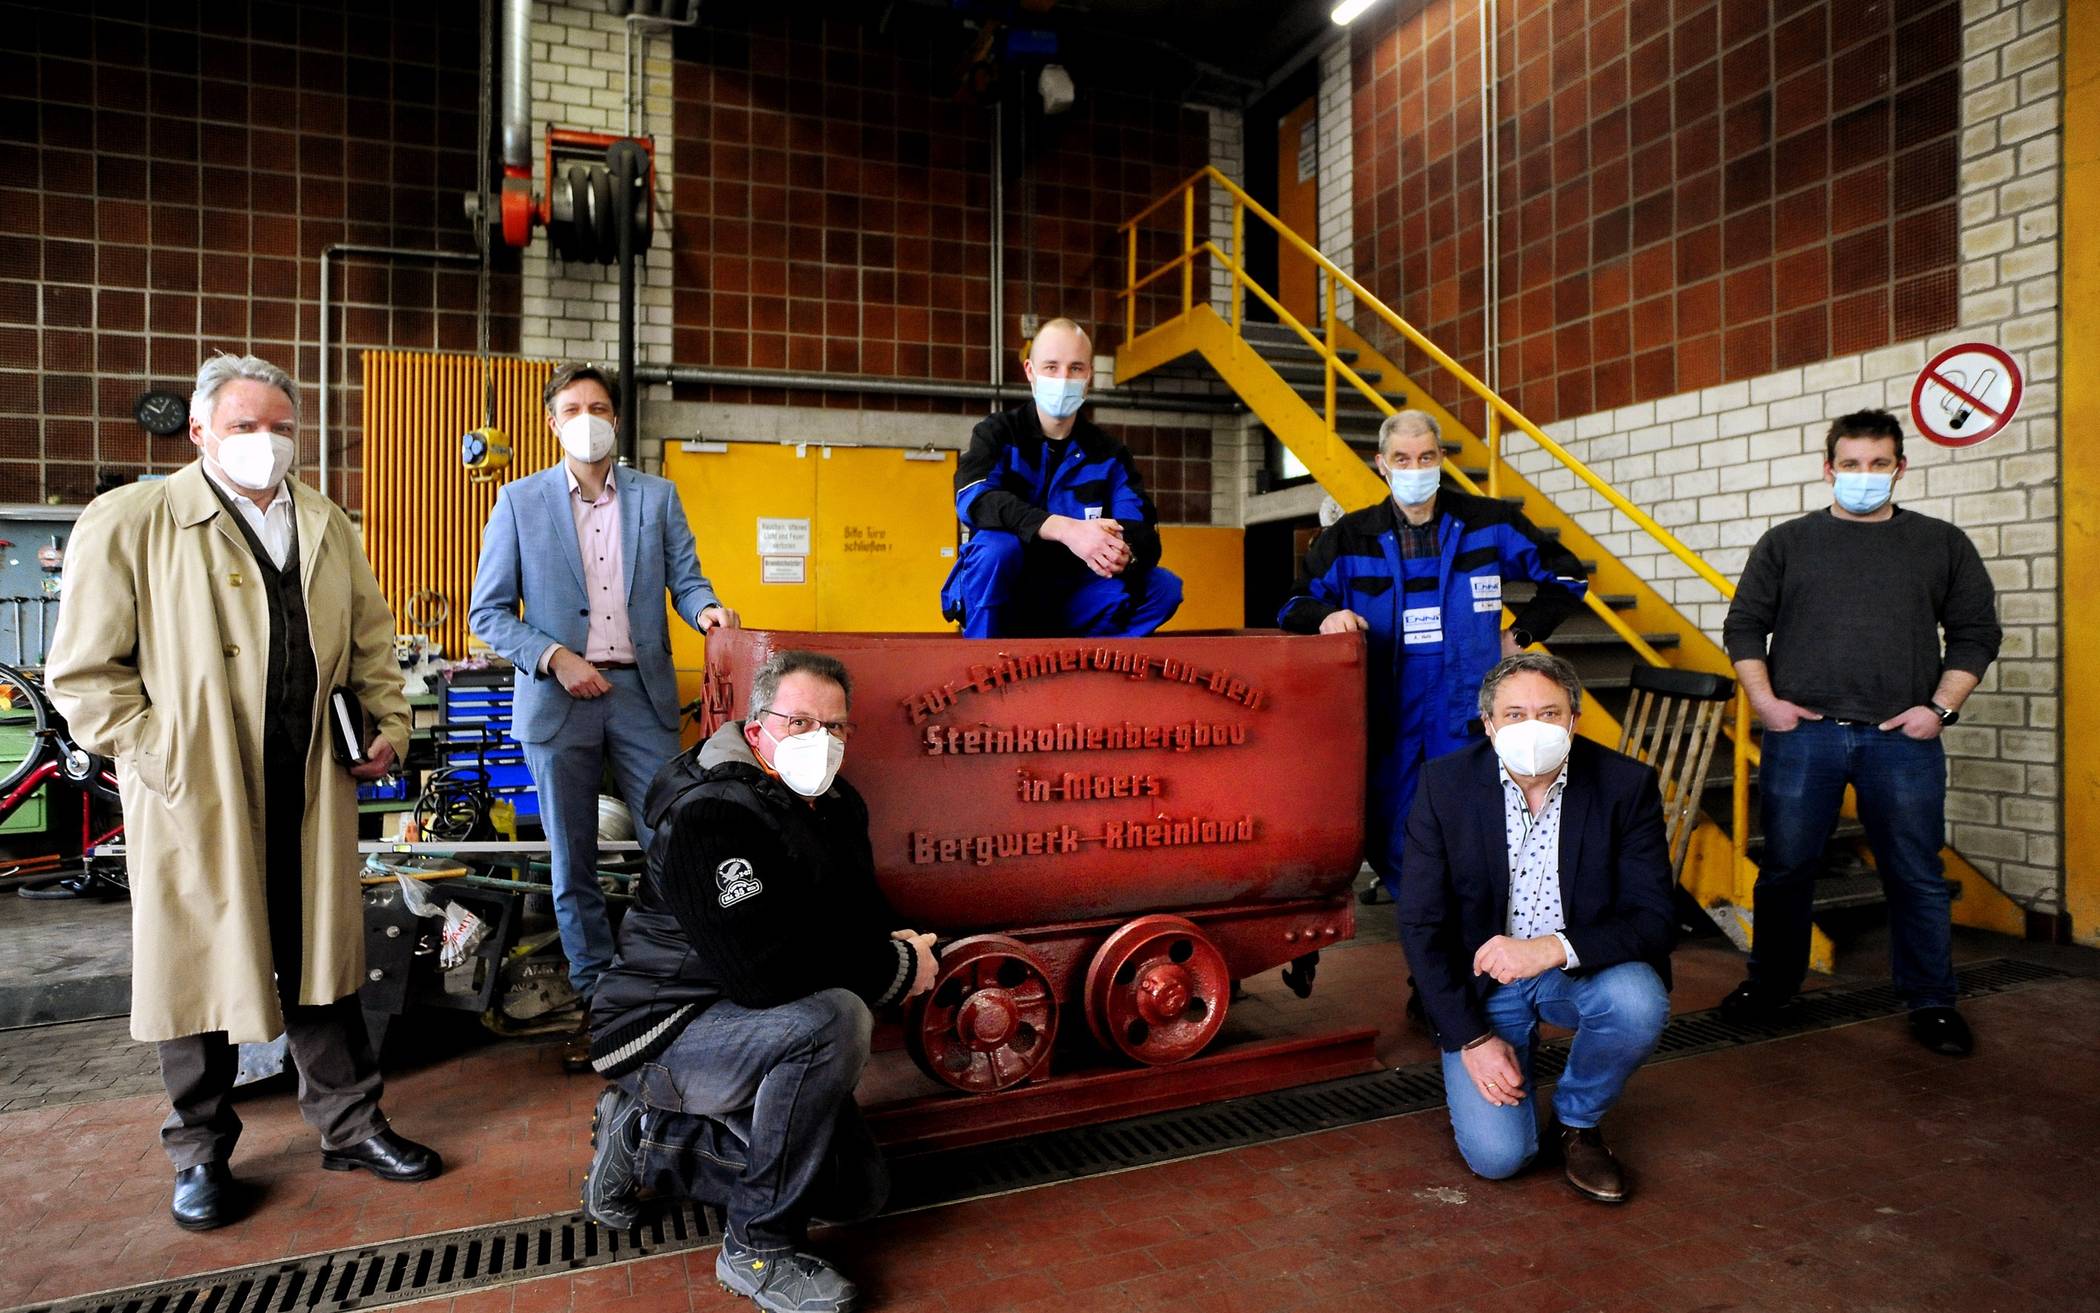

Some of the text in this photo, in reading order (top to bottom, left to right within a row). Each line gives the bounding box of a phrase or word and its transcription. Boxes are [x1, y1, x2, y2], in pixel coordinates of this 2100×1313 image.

[901, 648, 1265, 726] Zur Erinnerung an den
[925, 720, 1247, 756] Steinkohlenbergbau
[1016, 767, 1161, 802] in Moers
[912, 813, 1253, 867] Bergwerk Rheinland
